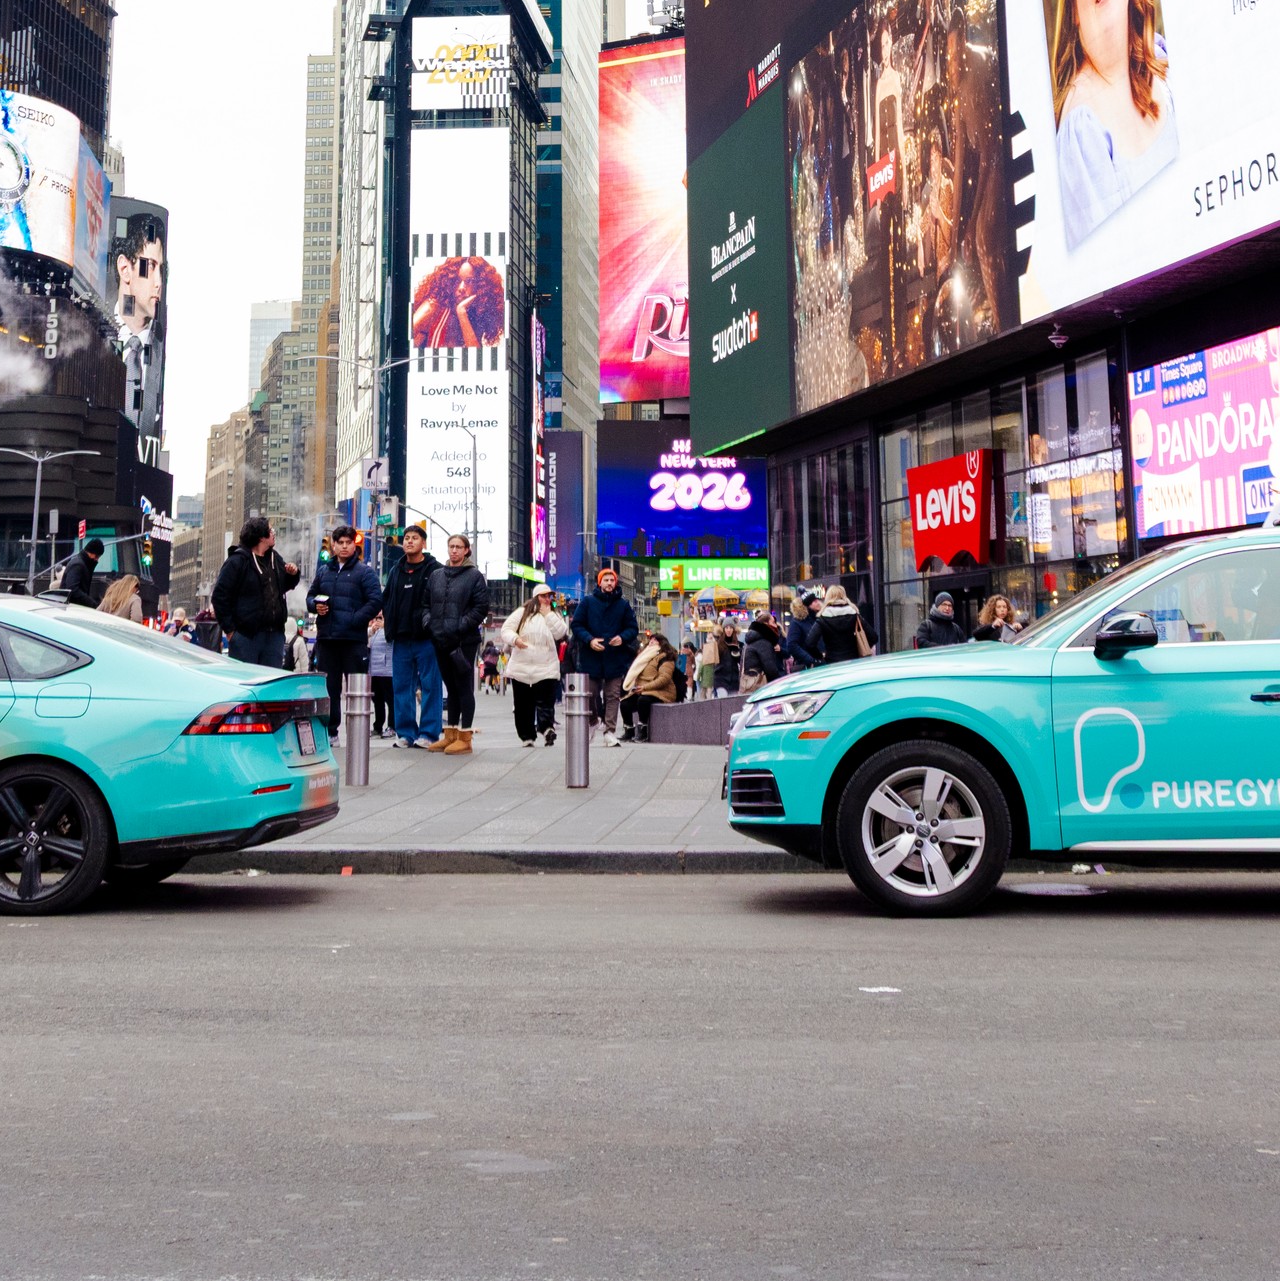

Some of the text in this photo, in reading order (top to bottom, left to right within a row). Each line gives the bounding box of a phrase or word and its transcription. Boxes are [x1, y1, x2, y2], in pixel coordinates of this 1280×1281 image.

[17, 106, 55, 127] SEIKO
[44, 298, 59, 360] 1500
[712, 309, 751, 363] swatch
[1161, 360, 1203, 383] Times Square
[421, 385, 498, 396] Love Me Not
[452, 402, 466, 413] by
[420, 418, 498, 431] Ravyn Lenae
[1157, 398, 1276, 467] PANDORA
[431, 451, 473, 461] Added
[660, 454, 696, 469] NEW
[446, 467, 471, 477] 548
[422, 483, 495, 496] situationhip
[649, 472, 751, 511] 2026
[1251, 481, 1274, 508] ONE
[548, 452, 557, 577] NOVEMBER 14
[688, 568, 721, 581] LINE
